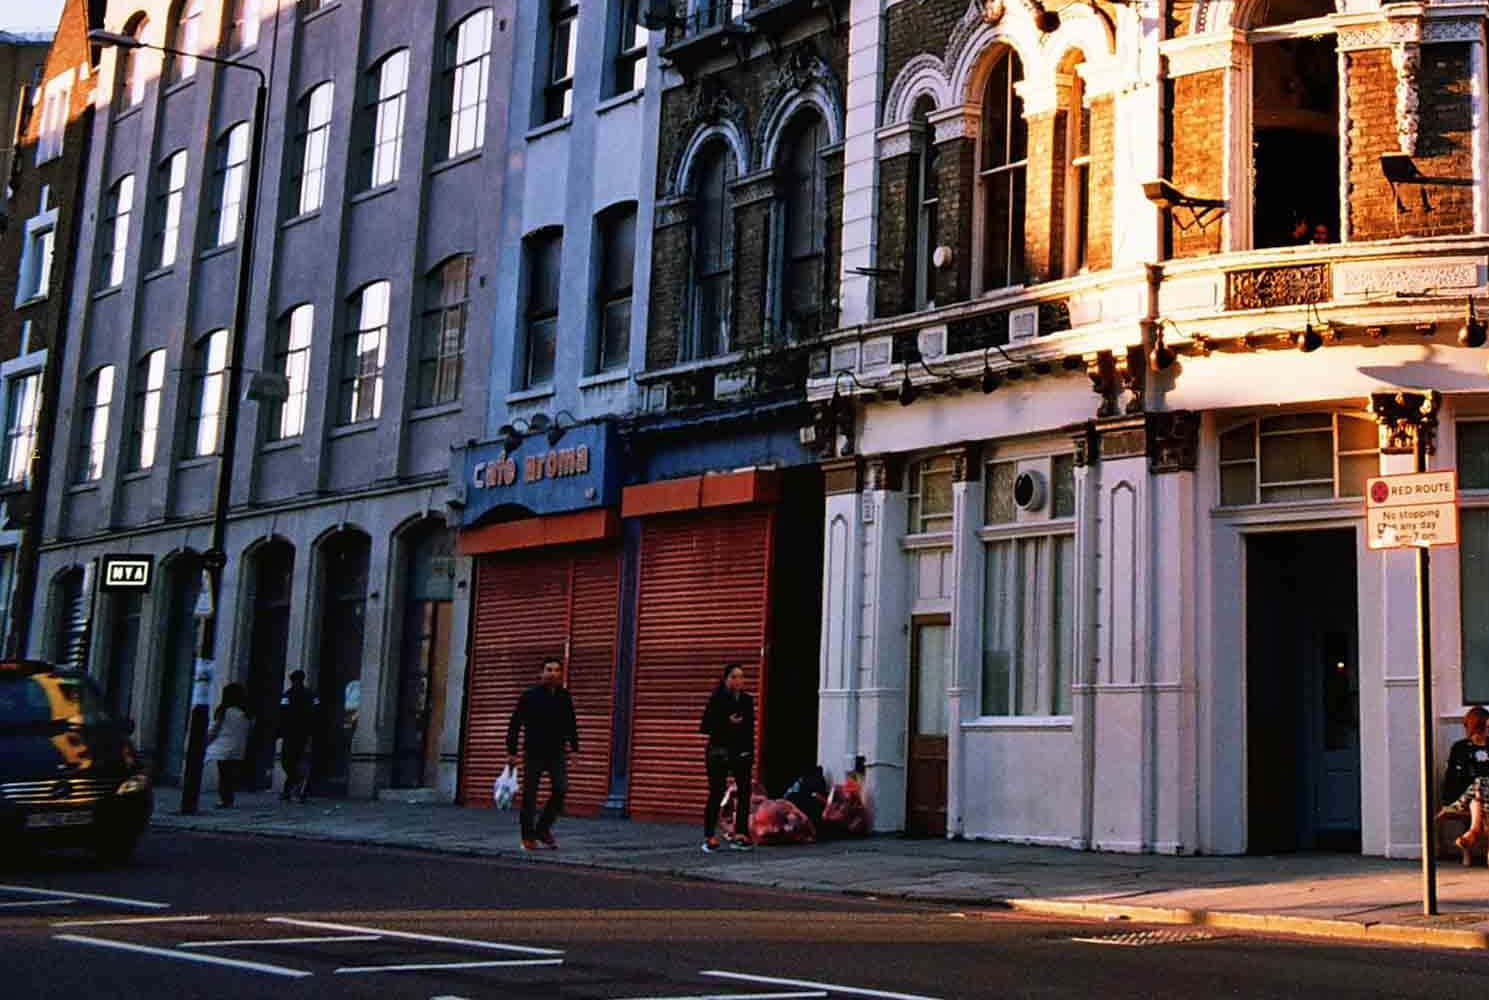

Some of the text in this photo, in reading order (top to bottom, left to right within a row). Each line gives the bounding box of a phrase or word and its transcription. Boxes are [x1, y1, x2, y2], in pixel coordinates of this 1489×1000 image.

[1391, 482, 1450, 496] RED ROUTE
[1383, 508, 1440, 521] No stopping
